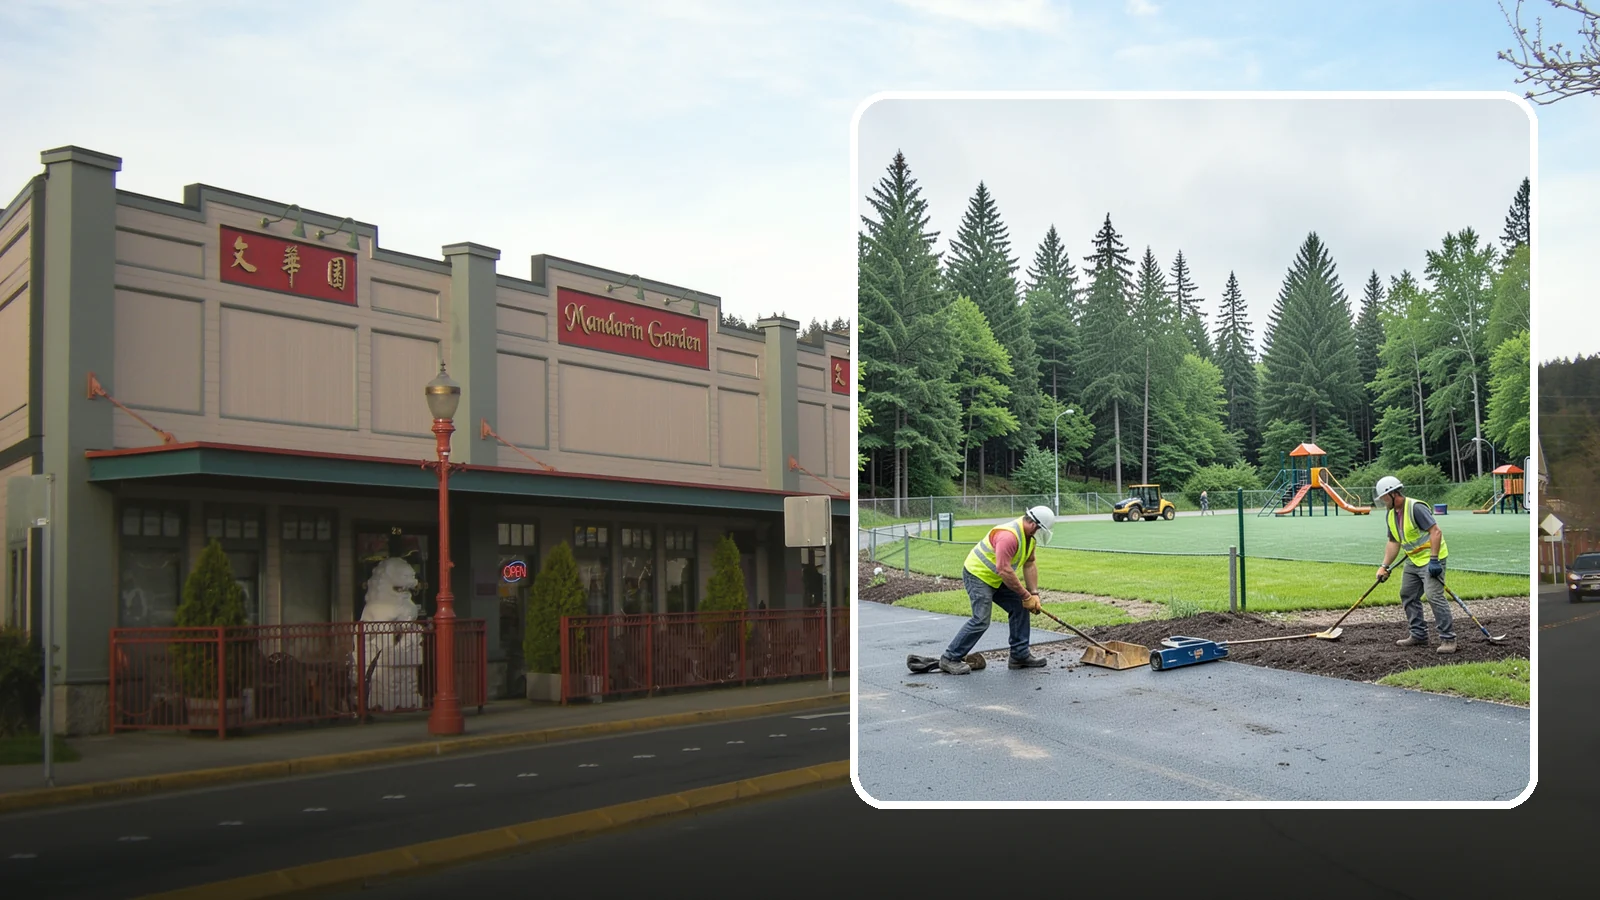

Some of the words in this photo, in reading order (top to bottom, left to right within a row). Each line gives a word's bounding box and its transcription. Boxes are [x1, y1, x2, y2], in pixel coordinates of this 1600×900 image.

[230, 235, 346, 291] 文華園
[564, 302, 644, 341] Mandarin
[647, 320, 702, 352] Garden
[835, 363, 846, 386] 文
[503, 565, 527, 578] OPEN
